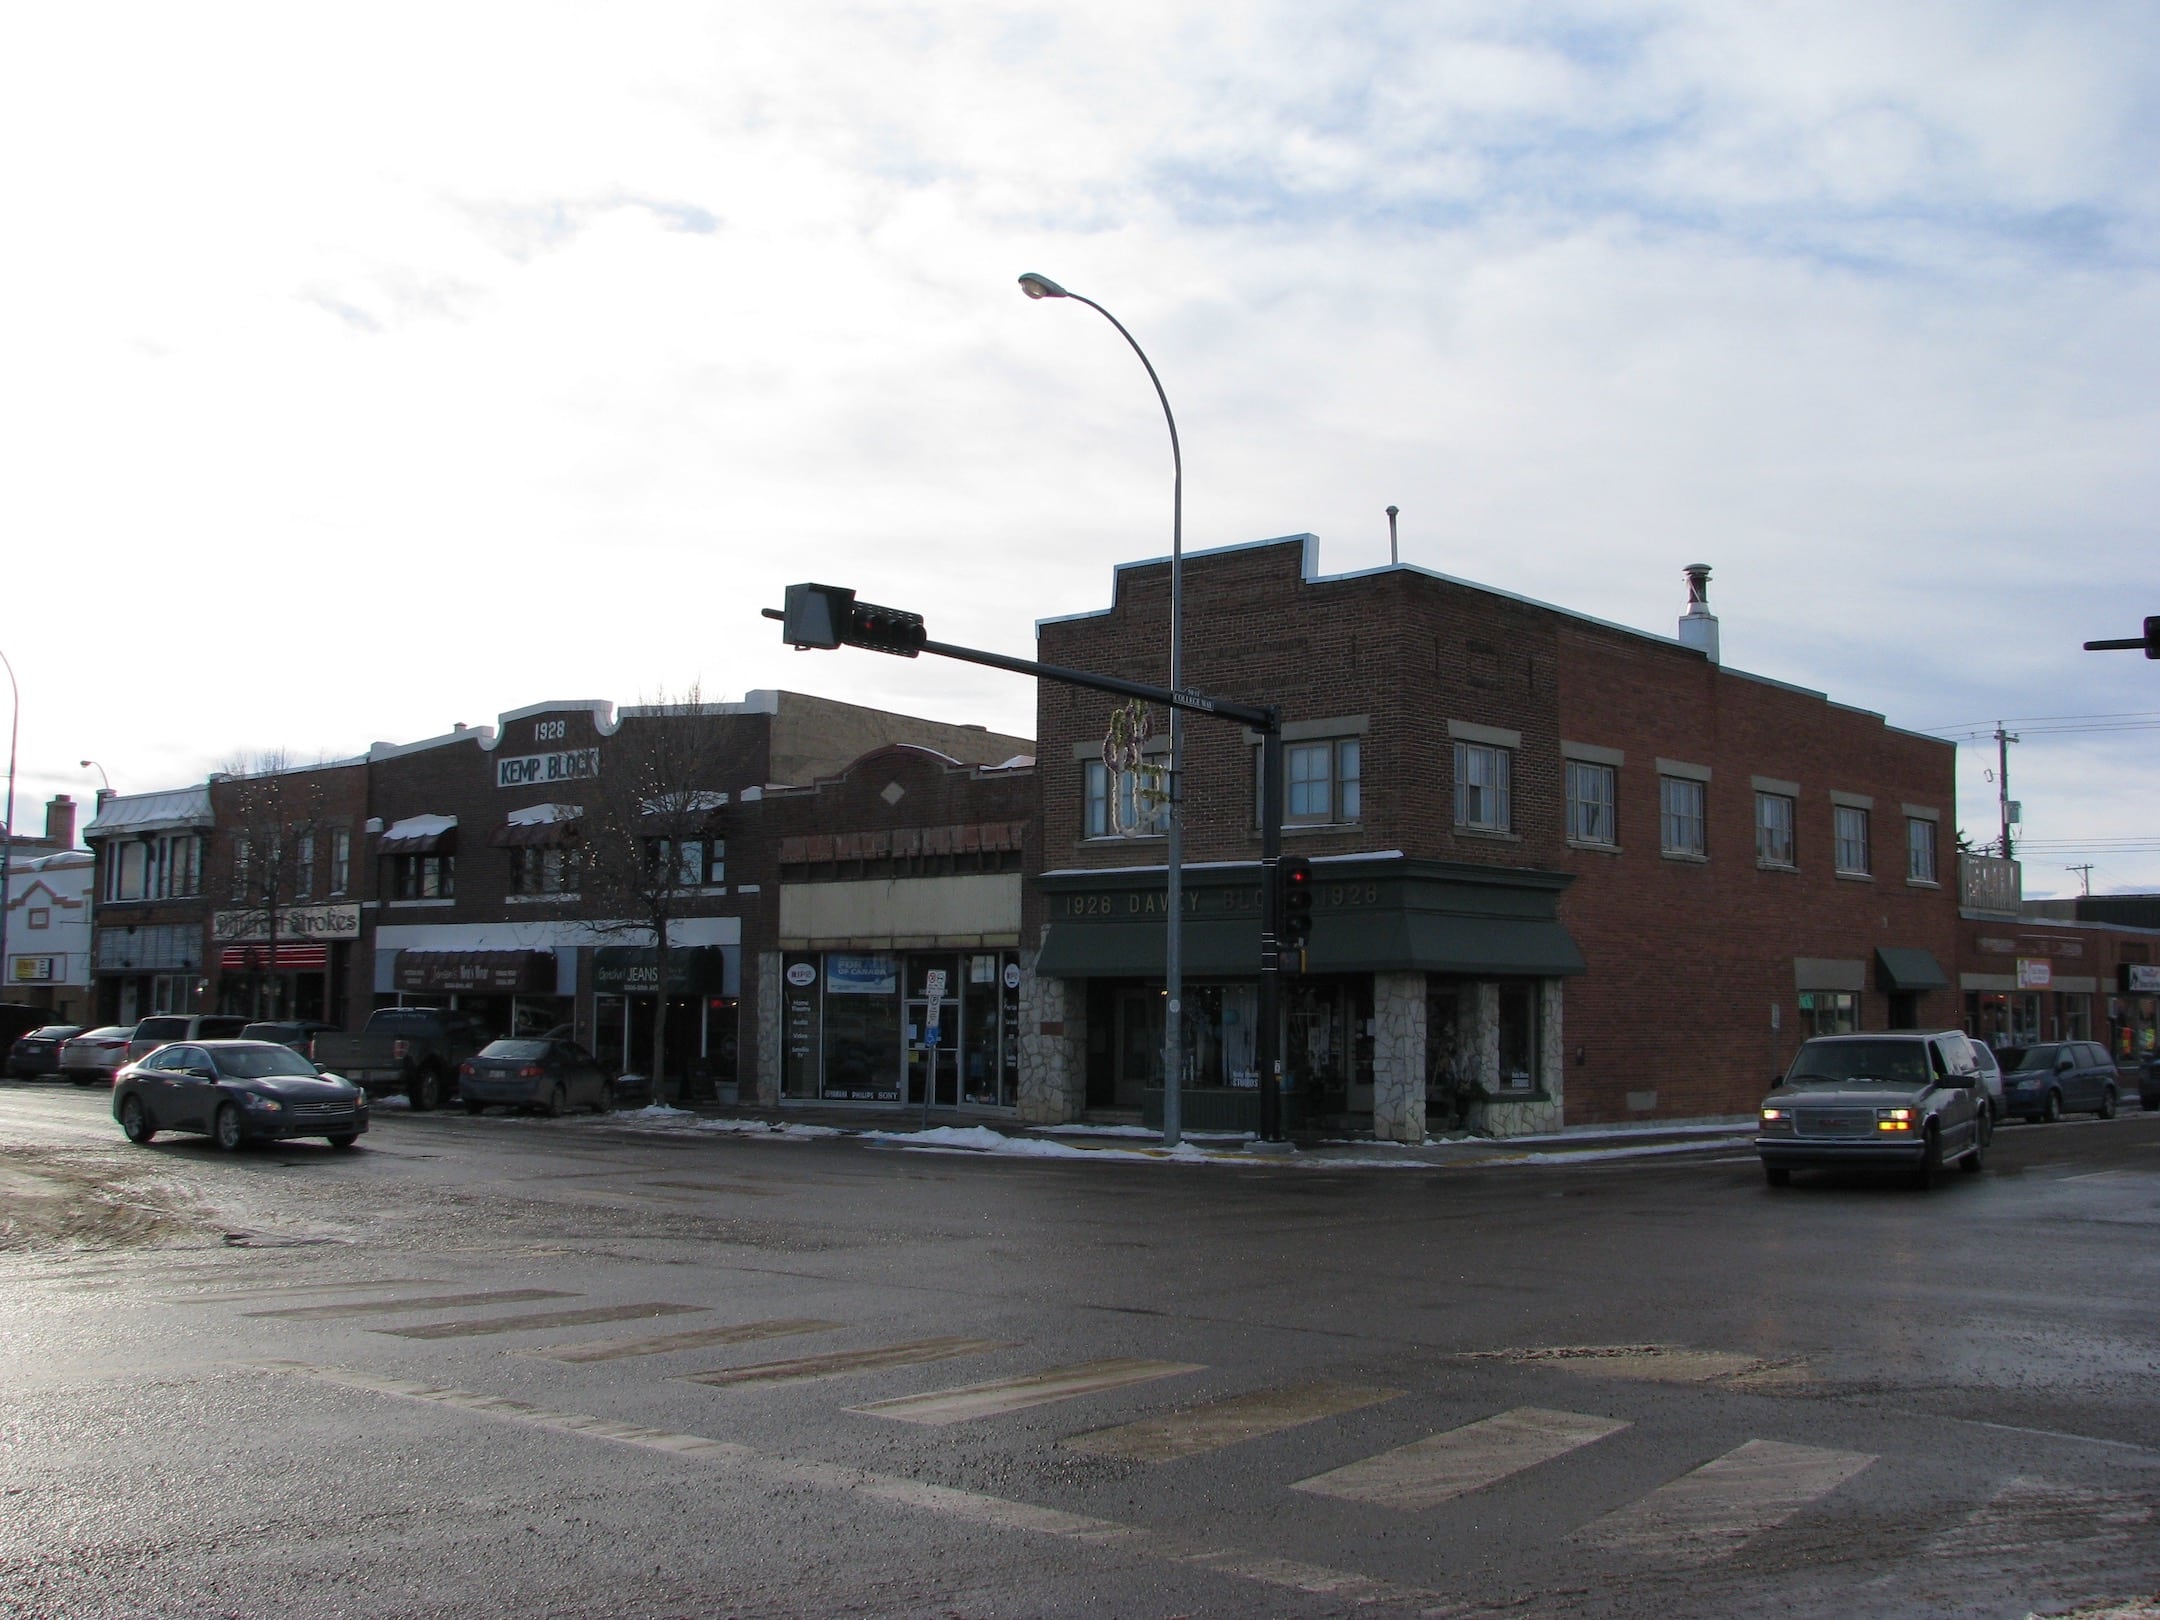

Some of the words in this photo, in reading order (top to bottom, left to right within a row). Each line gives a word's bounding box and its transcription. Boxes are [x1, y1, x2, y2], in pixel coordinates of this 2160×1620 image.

[1174, 693, 1200, 706] COLLEGE
[1201, 699, 1213, 709] WAY
[534, 719, 566, 741] 1928
[1066, 895, 1112, 915] 1926
[1129, 890, 1200, 913] DAVY
[1321, 883, 1378, 906] 1926
[628, 966, 659, 982] JEANS
[849, 968, 887, 977] CANADA
[878, 1091, 898, 1100] SONY
